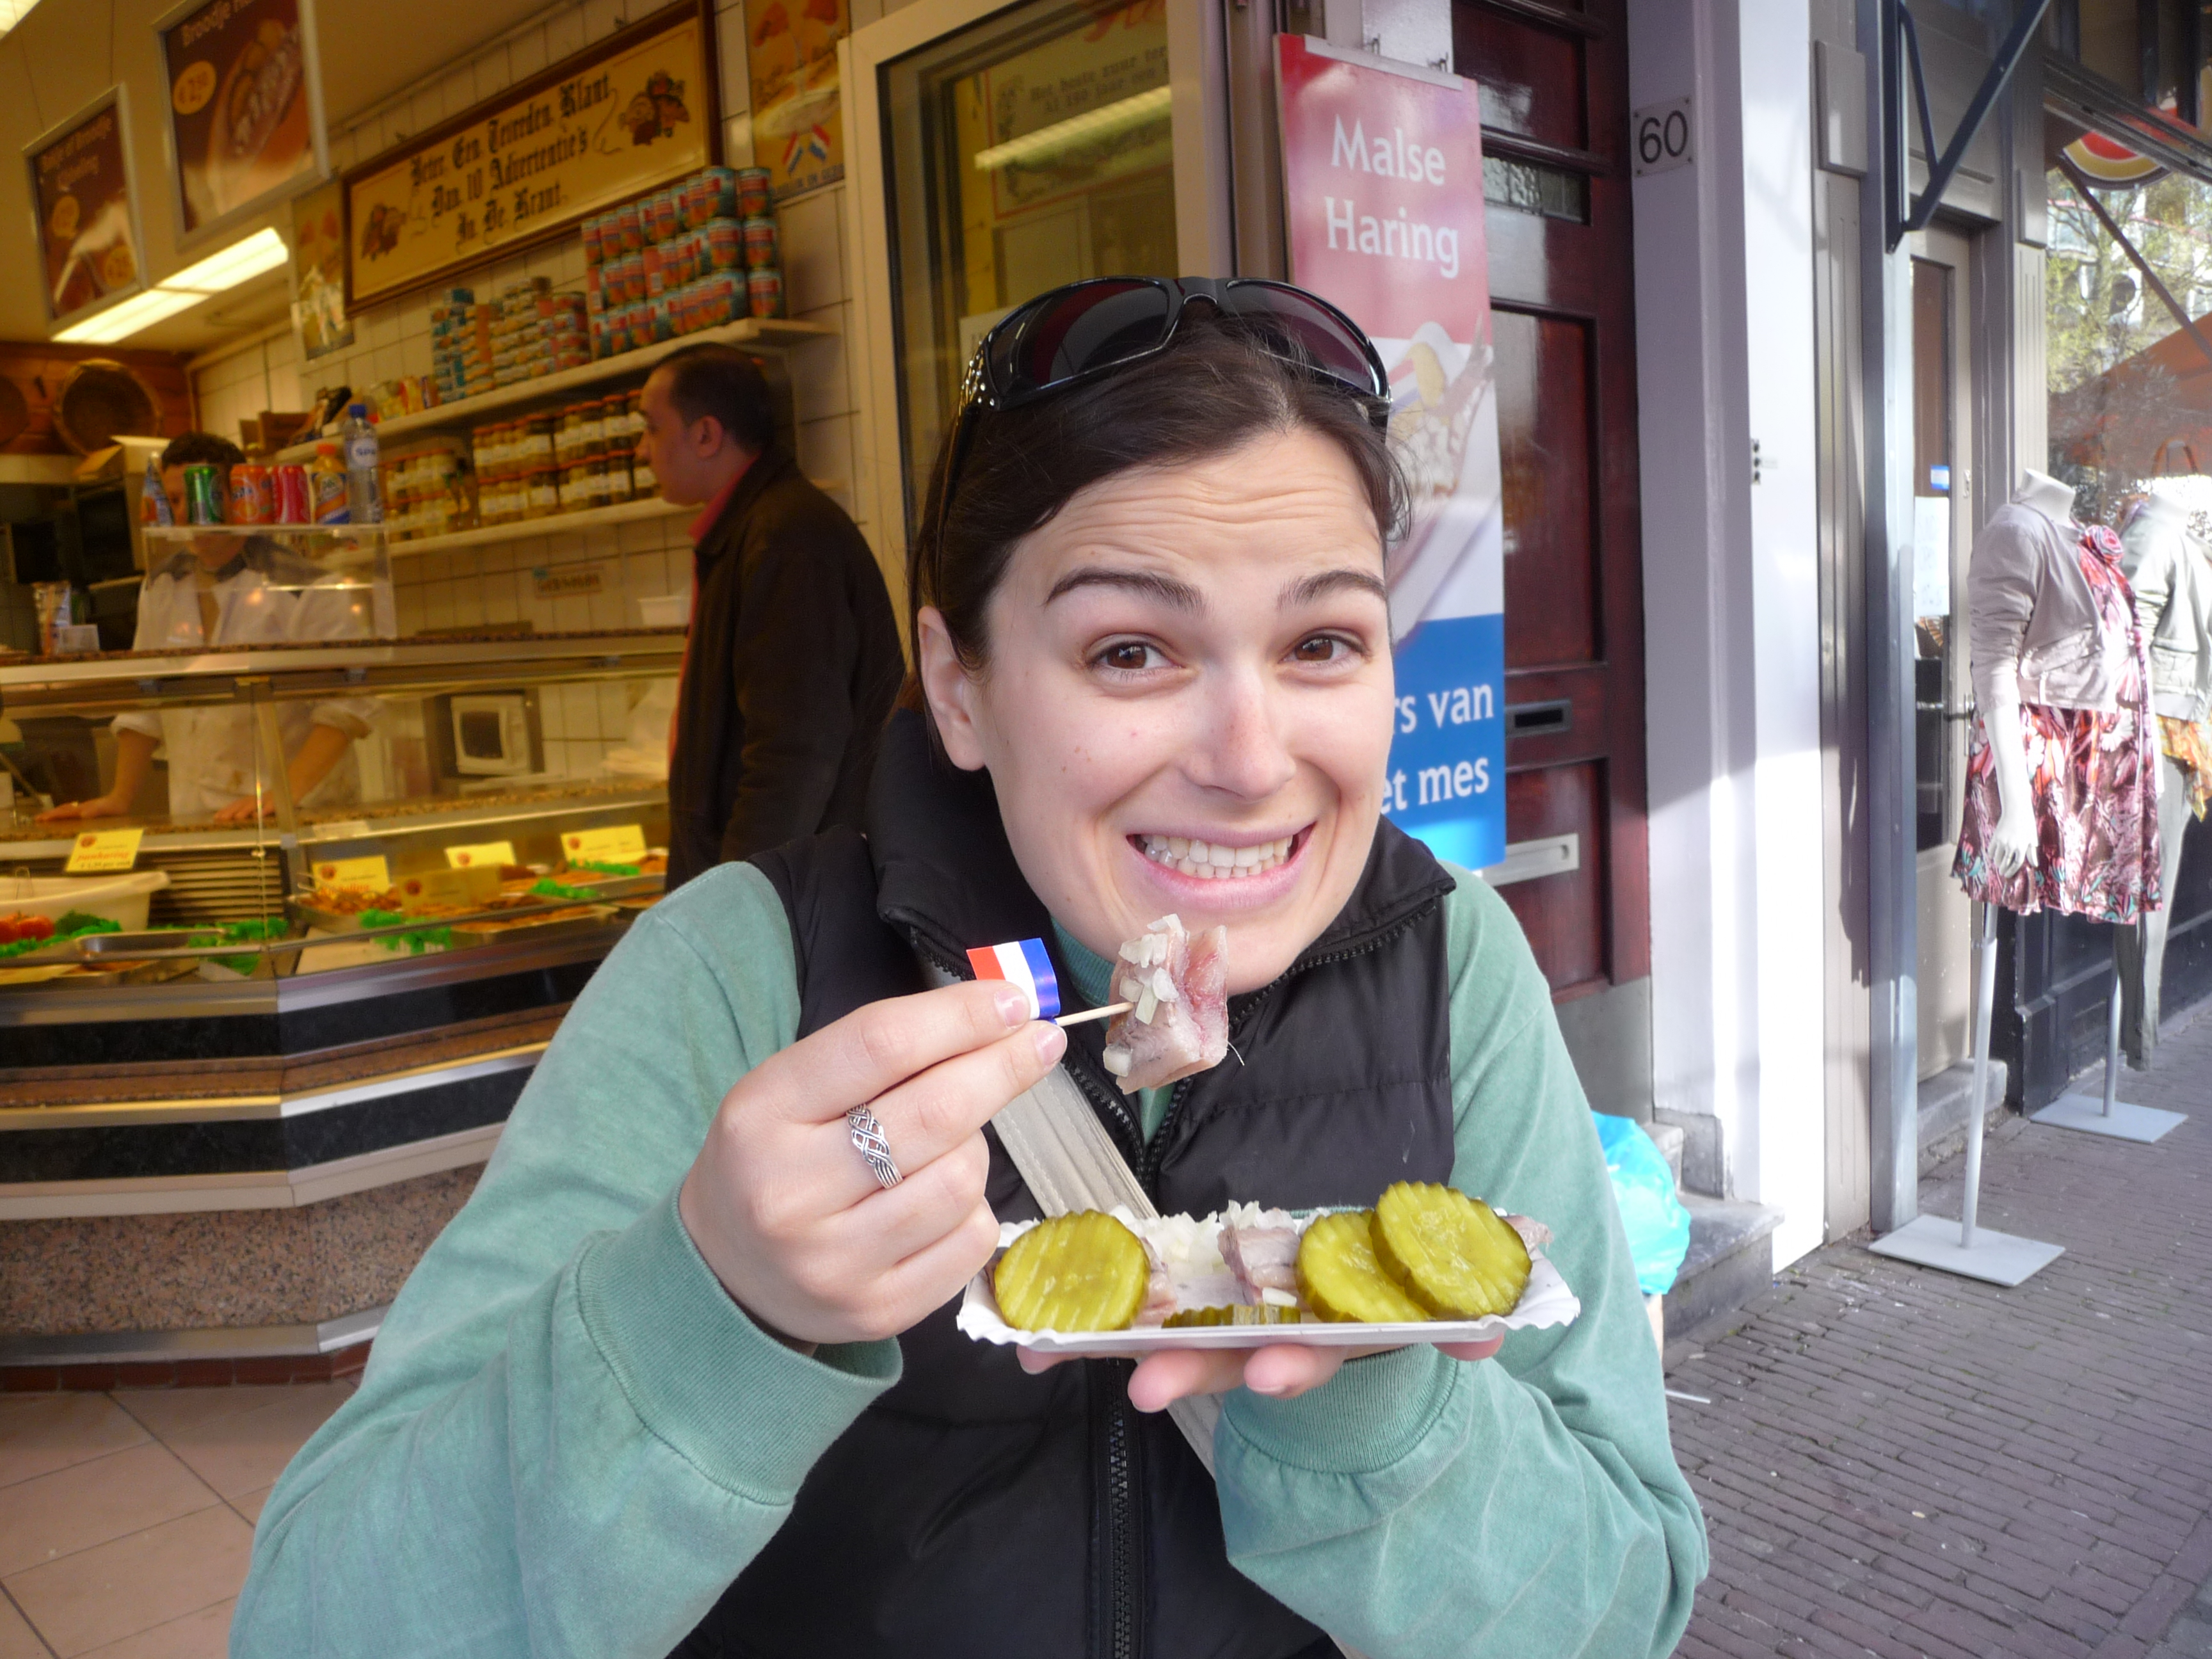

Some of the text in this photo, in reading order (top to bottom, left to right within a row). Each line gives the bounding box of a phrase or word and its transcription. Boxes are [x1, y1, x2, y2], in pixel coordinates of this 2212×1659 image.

[1331, 114, 1446, 186] Malse
[1639, 110, 1688, 164] 60
[1324, 196, 1459, 279] Haring
[1427, 684, 1494, 728] van
[1418, 757, 1490, 805] mes
